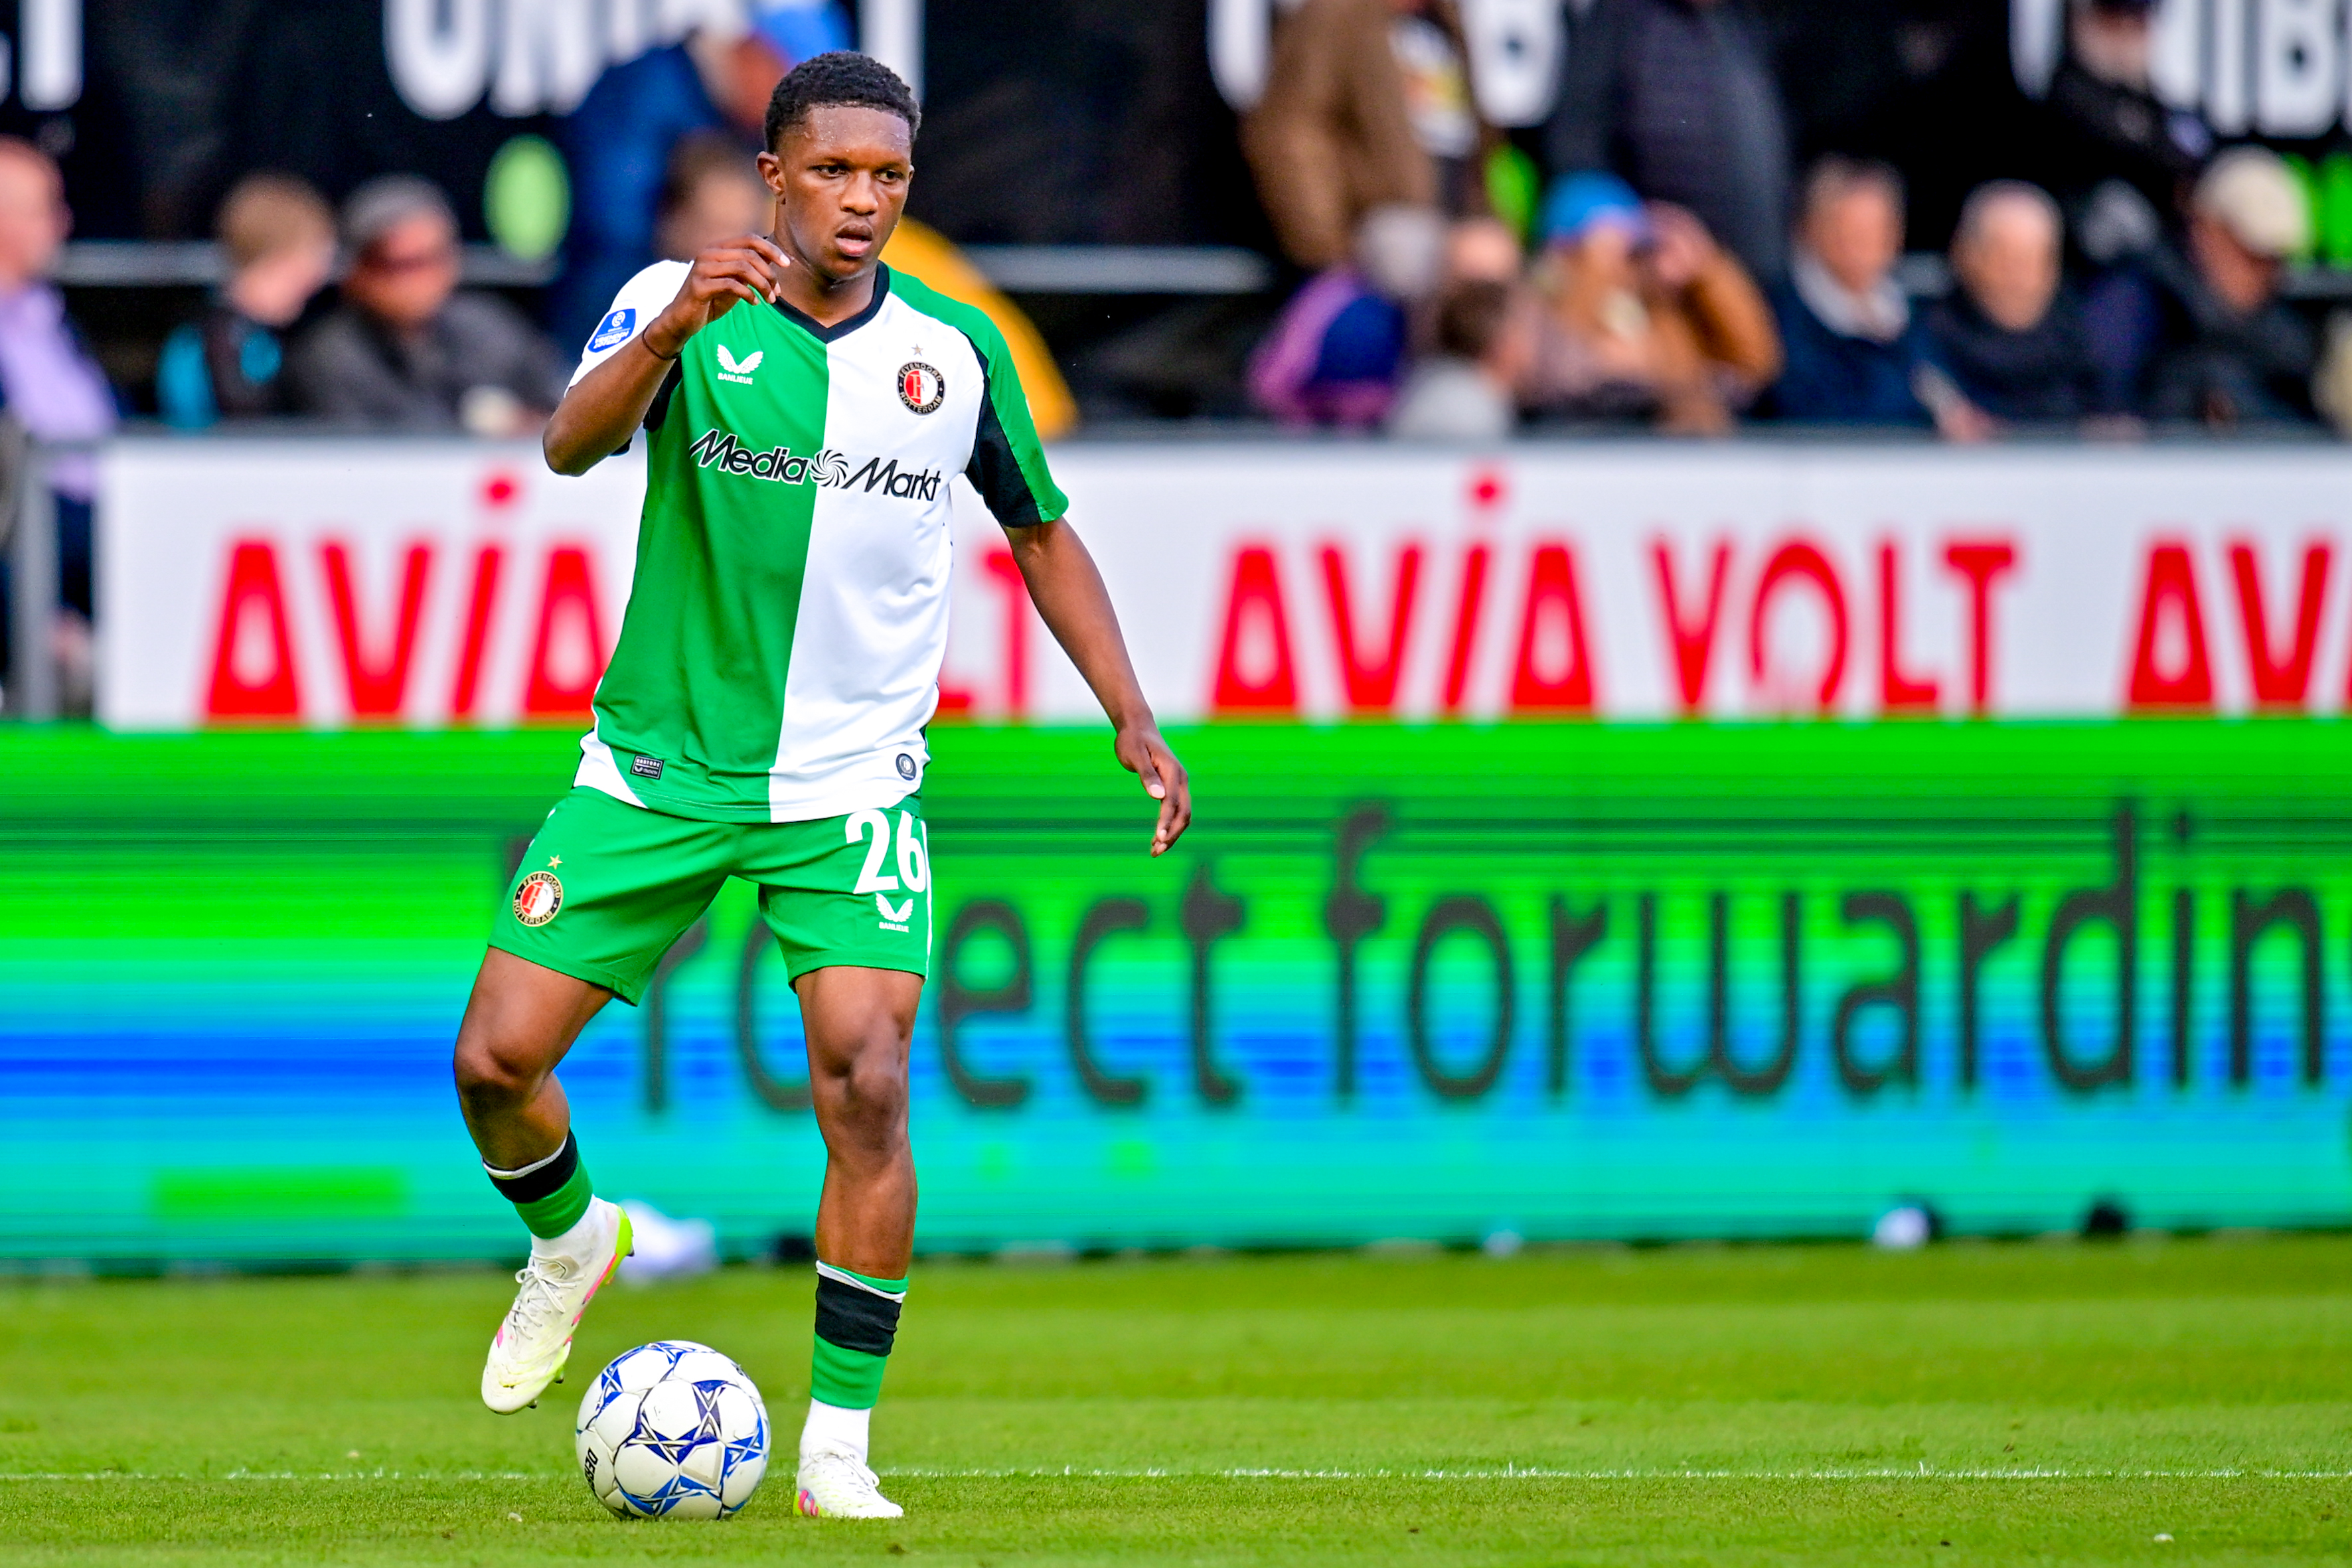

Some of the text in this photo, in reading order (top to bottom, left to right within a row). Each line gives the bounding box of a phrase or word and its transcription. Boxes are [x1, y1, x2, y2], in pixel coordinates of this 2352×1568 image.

[718, 372, 753, 385] BANLIEUE
[898, 362, 943, 382] FEYENOORD
[899, 391, 943, 414] ROTTERDAM
[689, 428, 941, 502] Media Markt
[2124, 541, 2352, 716] AV
[844, 808, 927, 895] 26
[522, 872, 562, 899] FEYENOORD
[514, 899, 554, 925] ROTTERDAM
[1324, 805, 2352, 1122] forwardin
